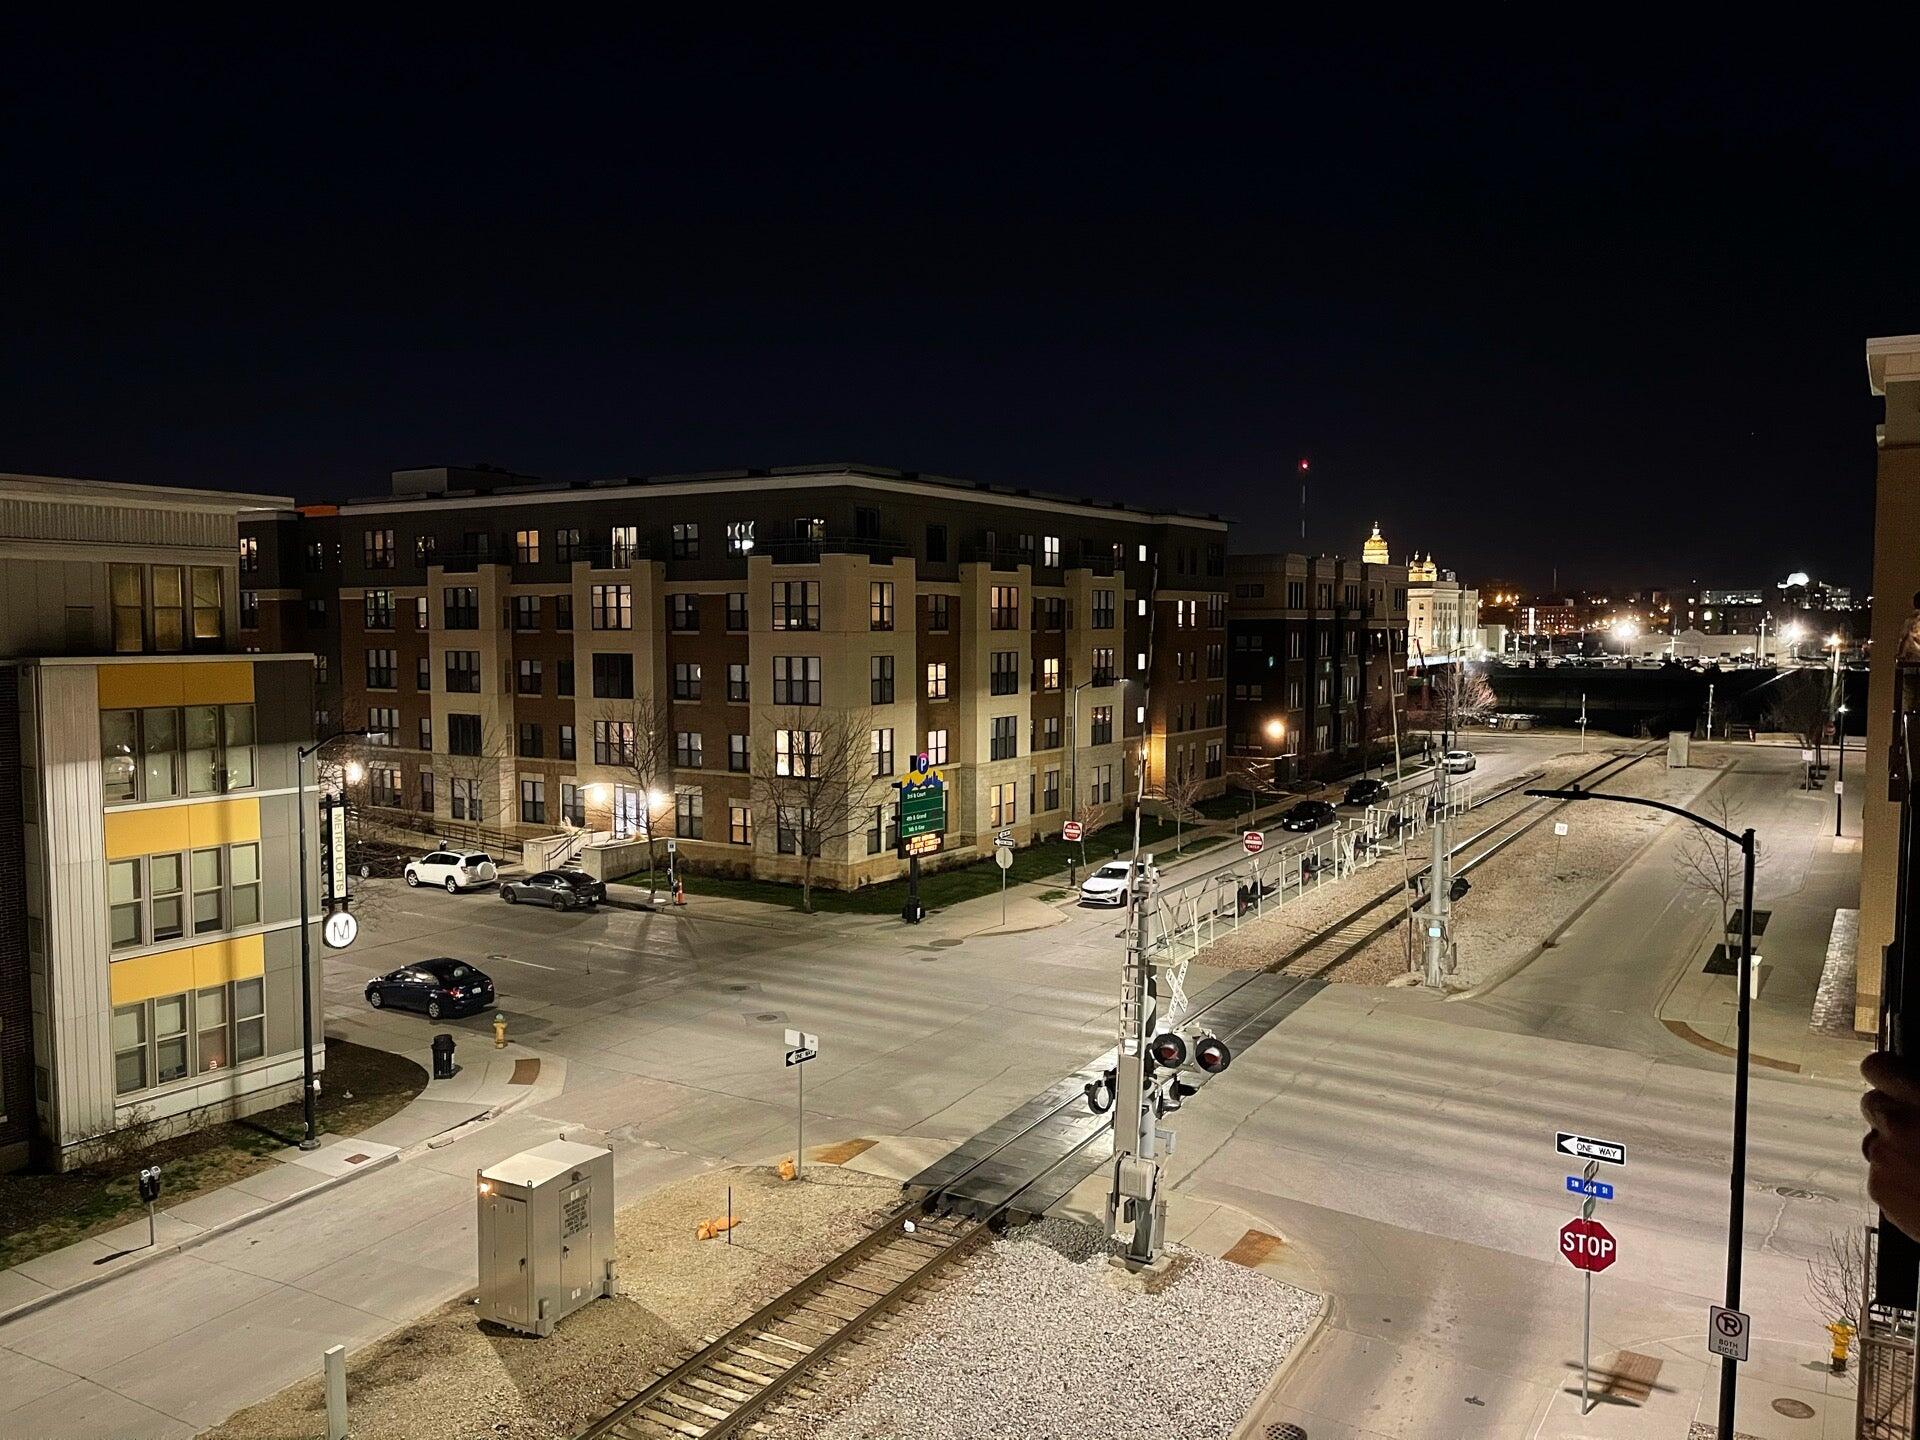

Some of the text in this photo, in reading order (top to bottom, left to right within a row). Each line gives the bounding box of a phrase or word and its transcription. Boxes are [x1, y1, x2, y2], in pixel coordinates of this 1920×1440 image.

[920, 757, 927, 771] P
[333, 813, 344, 892] METRO LOFTS
[334, 919, 350, 941] M
[1576, 1142, 1617, 1158] ONE WAY
[1584, 1184, 1597, 1194] 2nd
[1562, 1231, 1614, 1258] STOP
[1718, 1346, 1738, 1356] SIDES
[1719, 1338, 1738, 1349] BOTH
